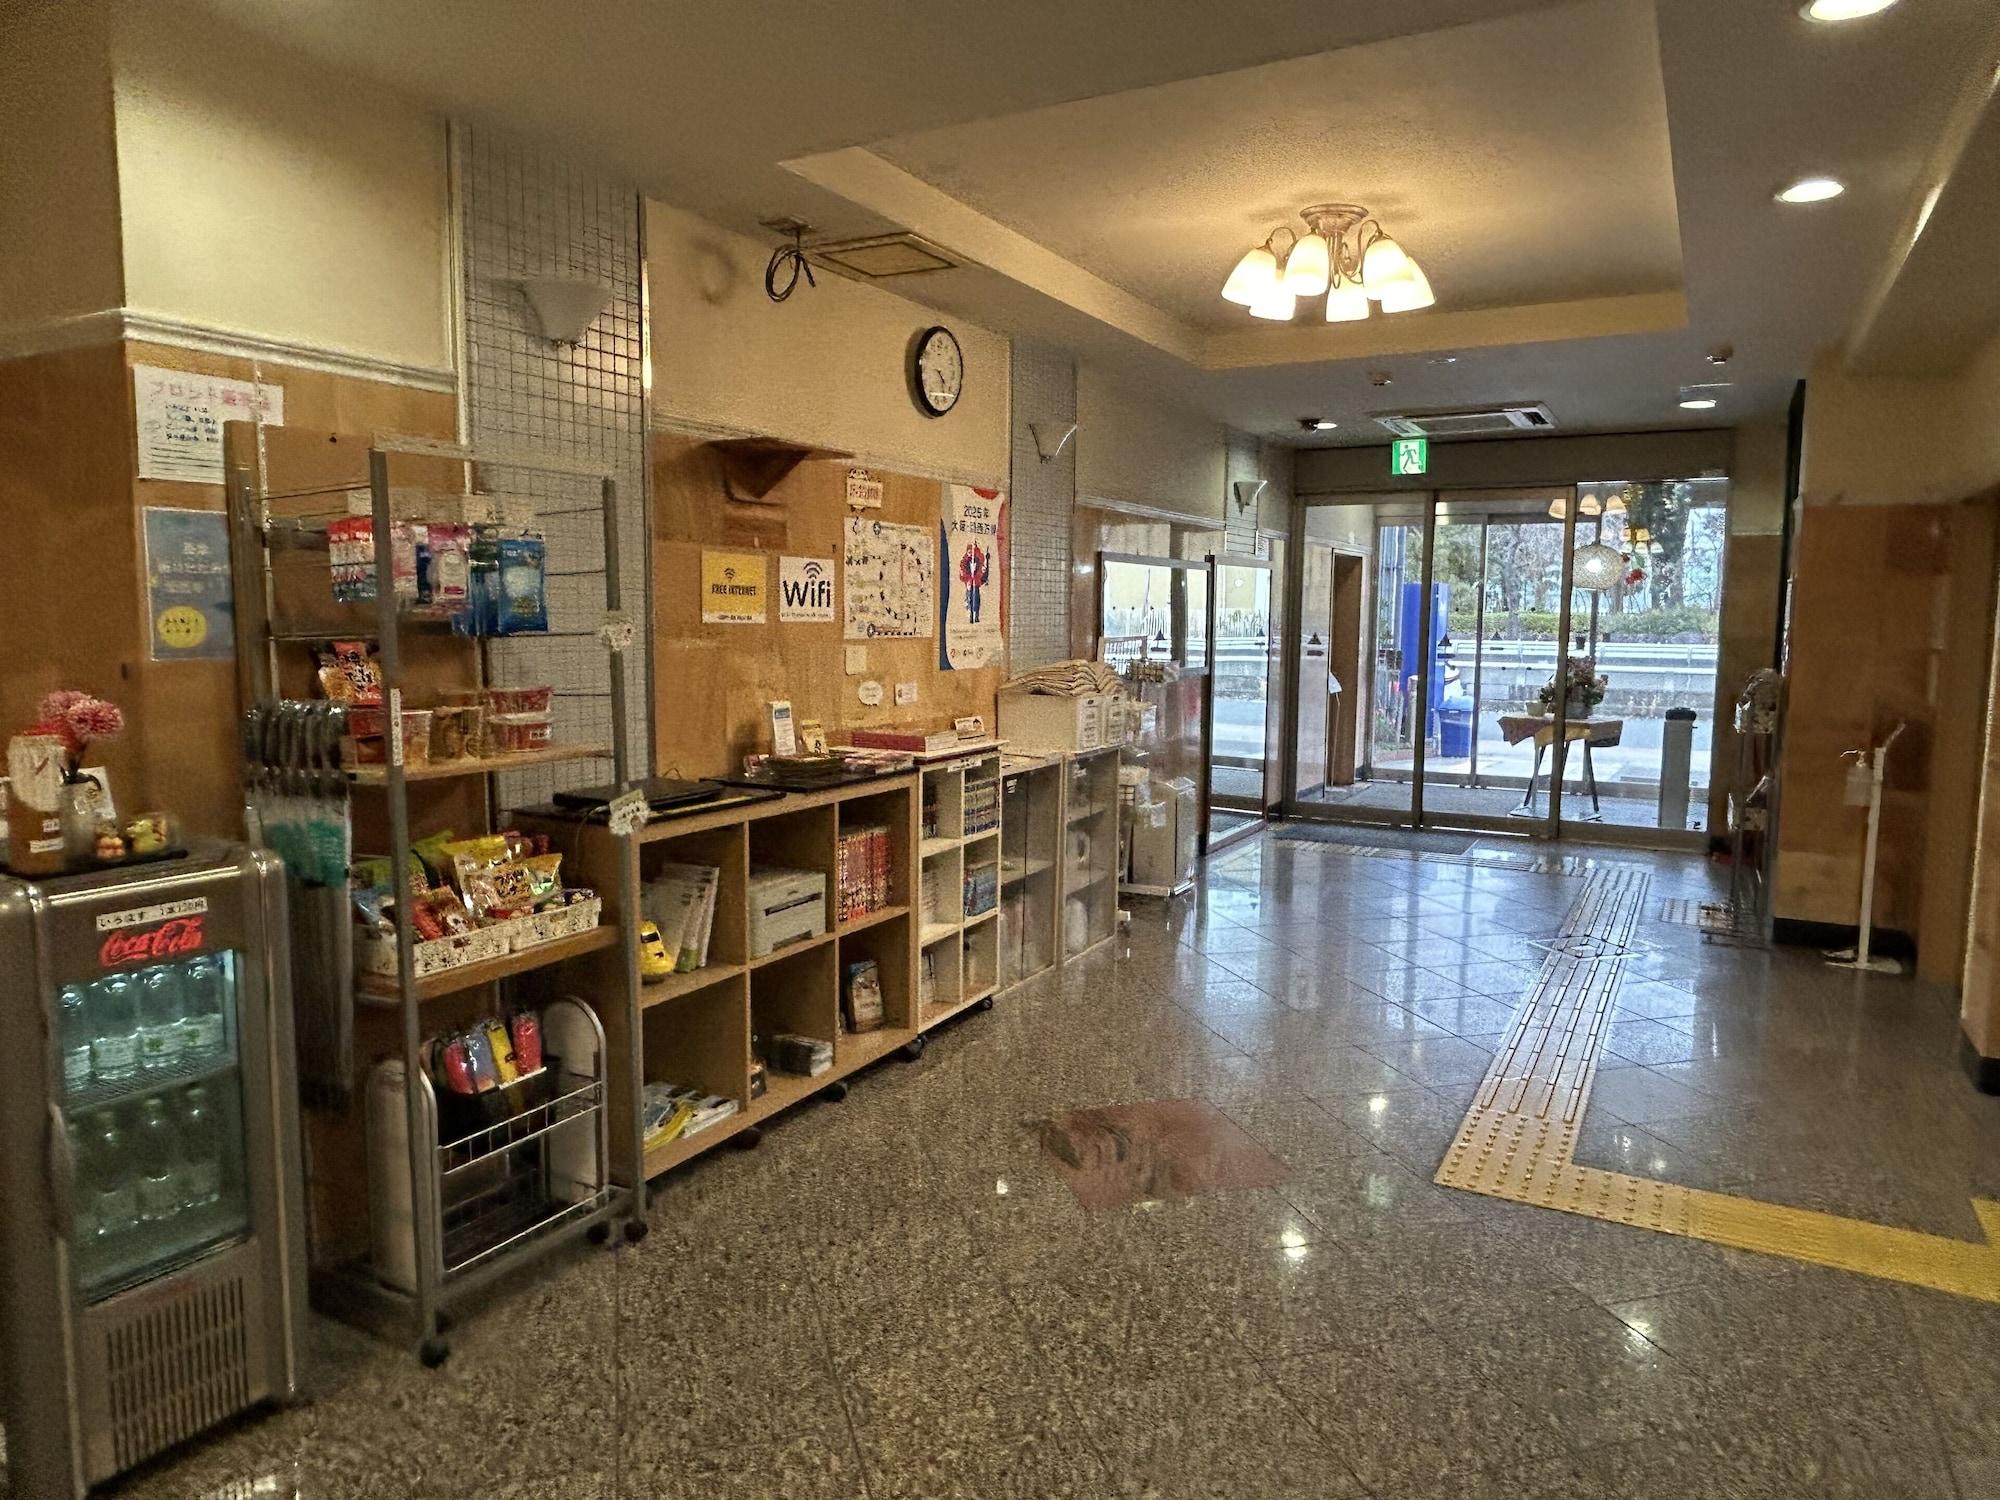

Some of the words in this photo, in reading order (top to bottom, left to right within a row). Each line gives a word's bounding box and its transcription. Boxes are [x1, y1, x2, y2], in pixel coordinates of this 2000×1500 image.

[963, 504, 989, 519] 2025年
[711, 583, 727, 595] FREE
[728, 585, 756, 596] INTERNET
[782, 580, 831, 607] Wifi
